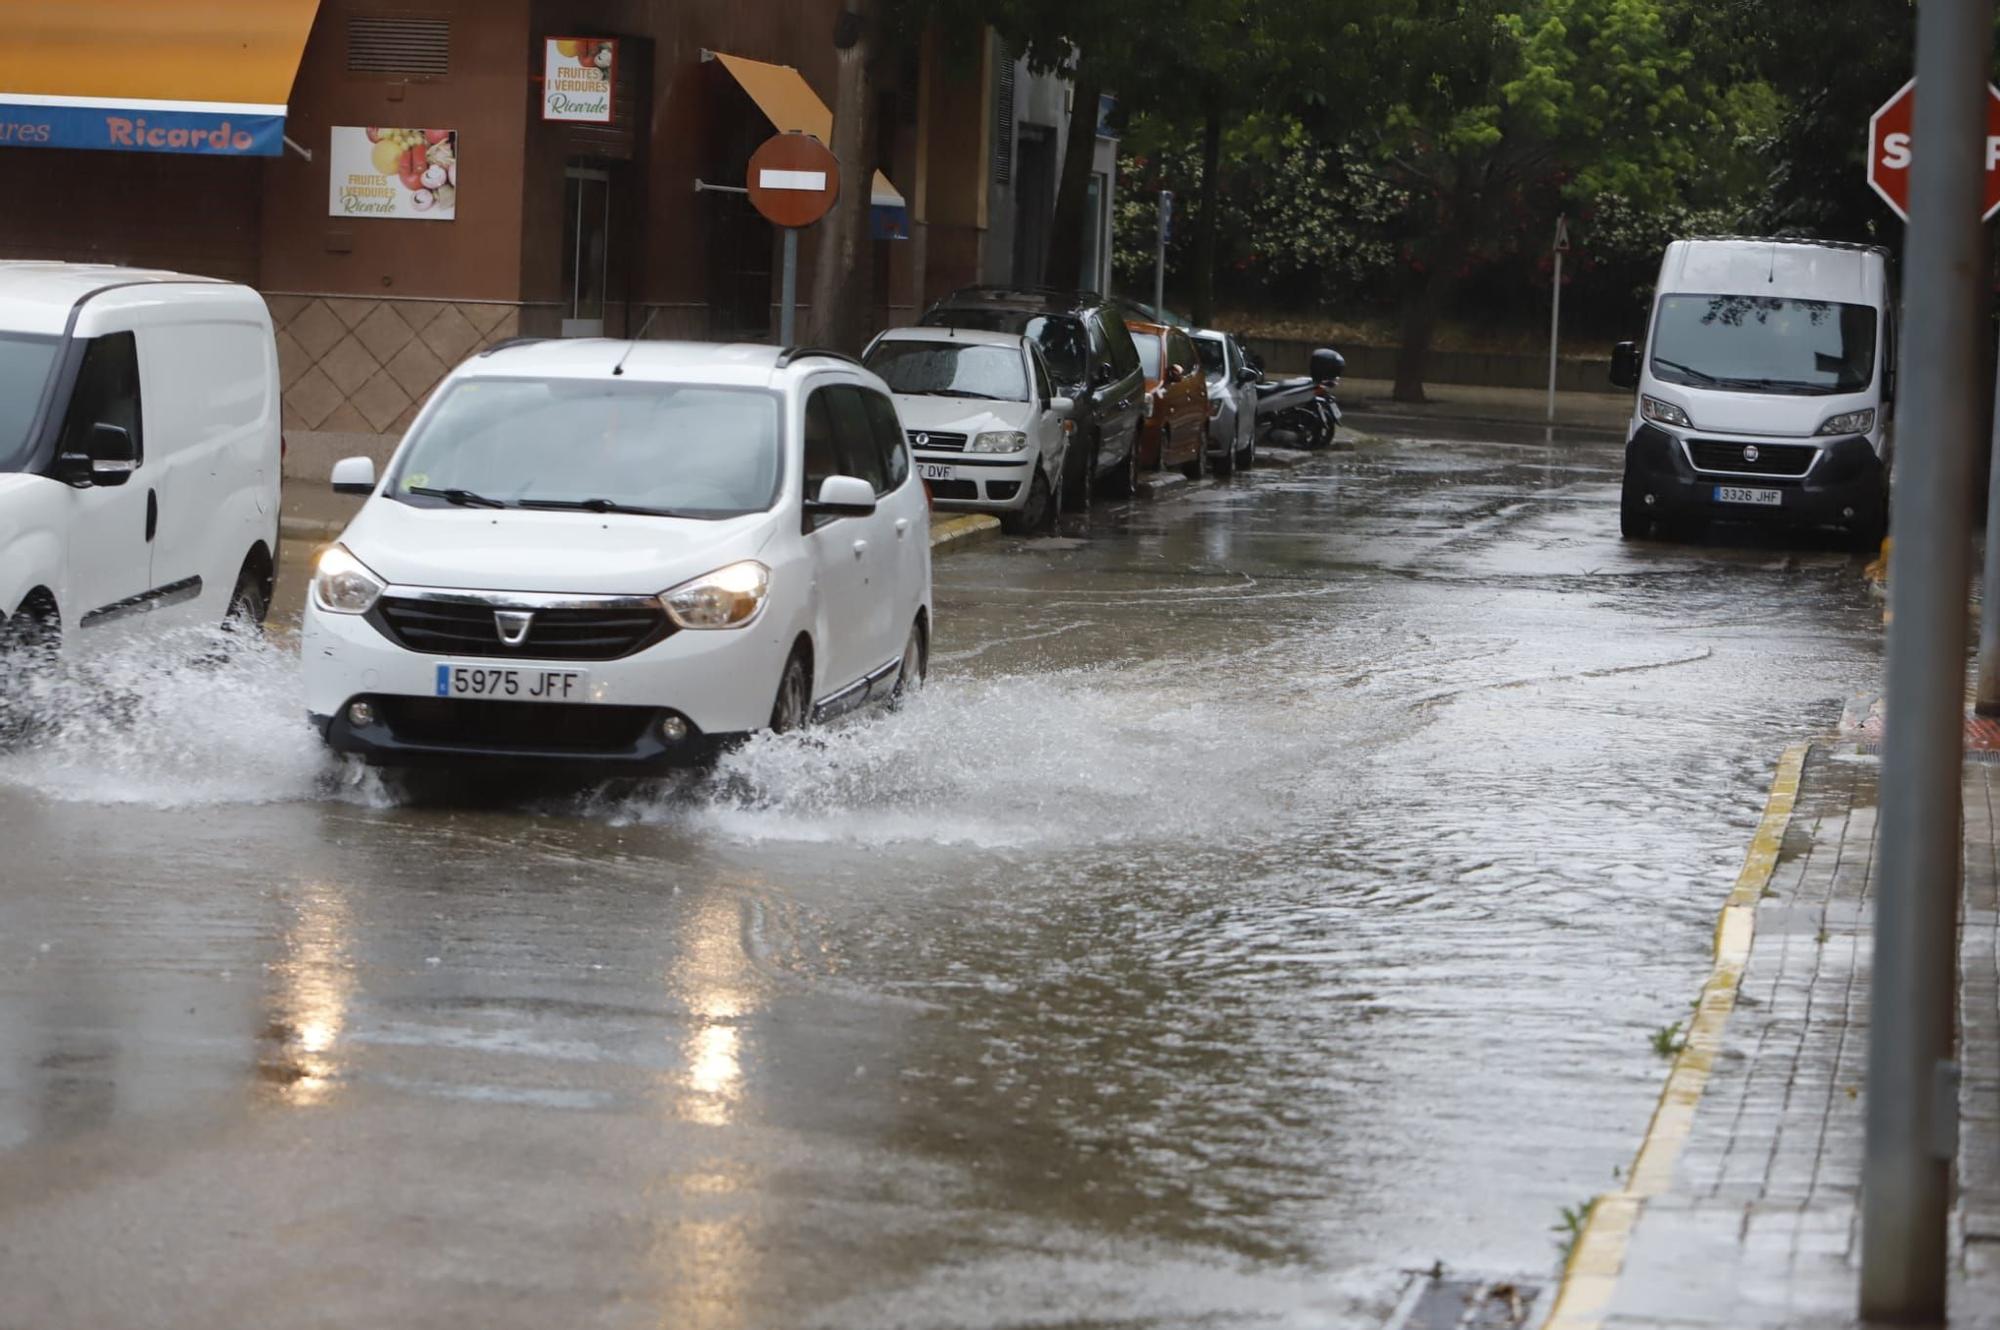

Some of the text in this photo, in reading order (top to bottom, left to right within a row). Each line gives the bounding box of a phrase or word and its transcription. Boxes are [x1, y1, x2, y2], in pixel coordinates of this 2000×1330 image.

[557, 66, 600, 80] FRUITES
[554, 79, 609, 93] VERDURES
[547, 92, 608, 114] Ricardo
[106, 116, 253, 150] Ricardo
[1881, 132, 2000, 171] SP
[347, 174, 387, 186] FRUITES
[339, 194, 396, 214] Ricardo
[1722, 488, 1778, 503] 3326 JHF
[455, 668, 578, 698] 5975 JFF
